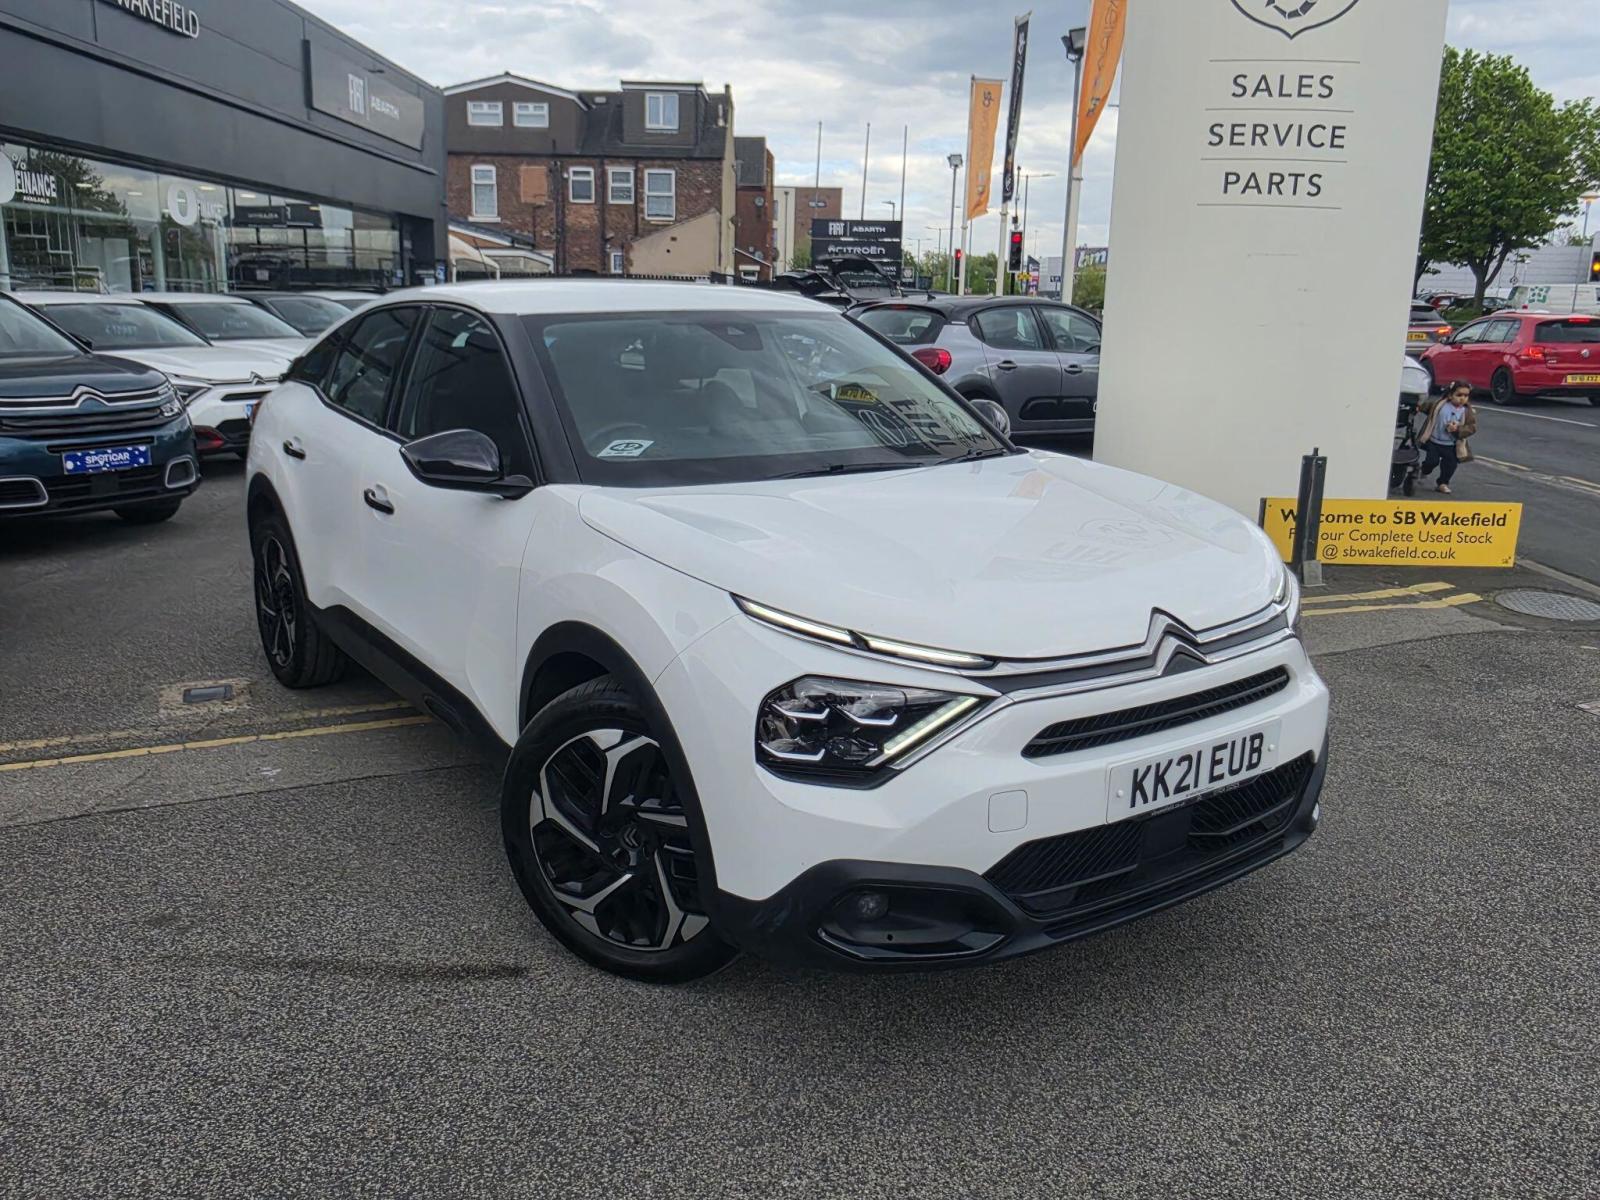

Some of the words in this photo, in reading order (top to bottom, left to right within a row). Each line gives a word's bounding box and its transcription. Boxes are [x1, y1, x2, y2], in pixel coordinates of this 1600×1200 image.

[1231, 74, 1335, 99] SALES
[1207, 123, 1347, 149] SERVICE
[15, 169, 57, 198] FINANCE
[1222, 171, 1323, 197] PARTS
[828, 221, 845, 236] FIAT
[852, 225, 886, 233] ABARTH
[85, 452, 130, 464] SPOTICAR
[1281, 508, 1364, 524] Wcome
[1369, 512, 1387, 524] to
[1393, 511, 1416, 525] SB
[1420, 511, 1507, 527] Wakefield
[1349, 529, 1413, 545] Complete
[1418, 530, 1452, 543] Used
[1456, 531, 1493, 544] Stock
[1322, 544, 1339, 560] @
[1342, 545, 1456, 560] sbwakefield.co.uk
[1130, 749, 1203, 808] KK21
[1208, 732, 1264, 784] EUB
